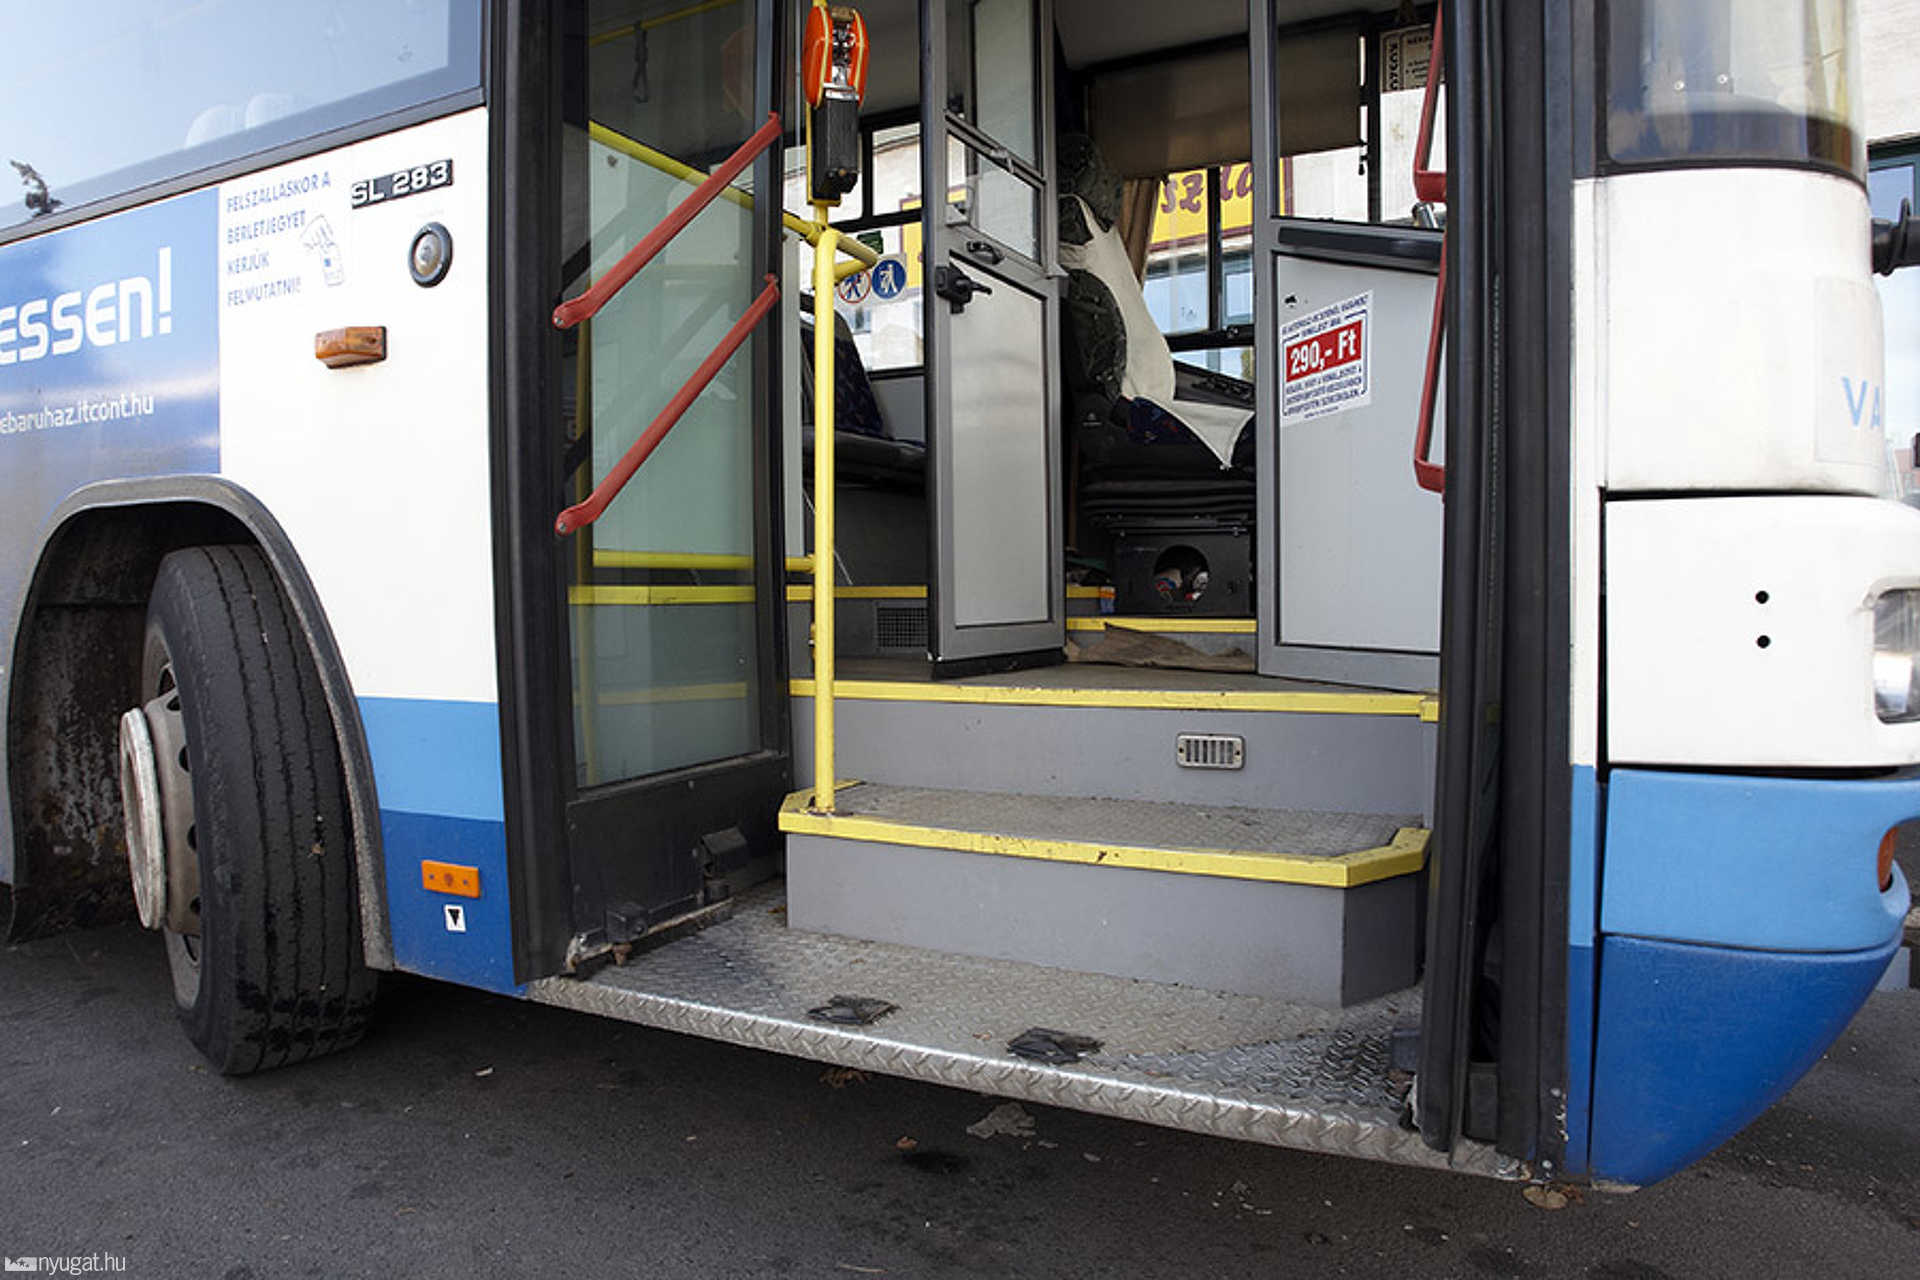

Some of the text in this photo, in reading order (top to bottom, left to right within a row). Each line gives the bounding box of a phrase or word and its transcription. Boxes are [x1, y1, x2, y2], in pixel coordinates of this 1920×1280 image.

[321, 170, 332, 188] A
[351, 161, 448, 206] SL 283
[1290, 328, 1358, 376] 290,- Ft
